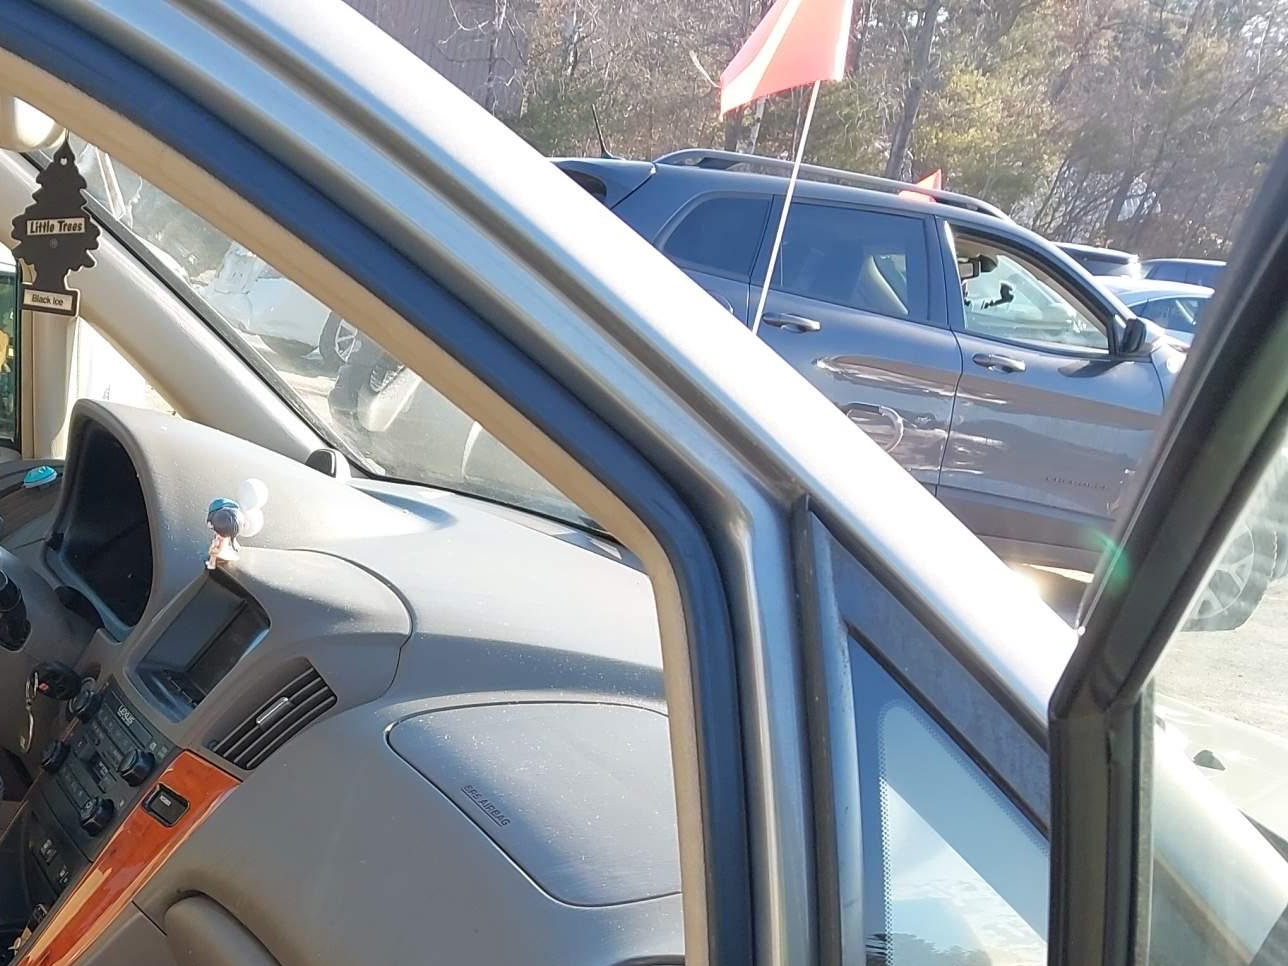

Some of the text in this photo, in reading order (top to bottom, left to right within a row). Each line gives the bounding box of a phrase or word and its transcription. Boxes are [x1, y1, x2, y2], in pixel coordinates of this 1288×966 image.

[29, 219, 83, 234] Little Trees
[31, 293, 51, 305] Black
[479, 799, 511, 827] AIRBAG
